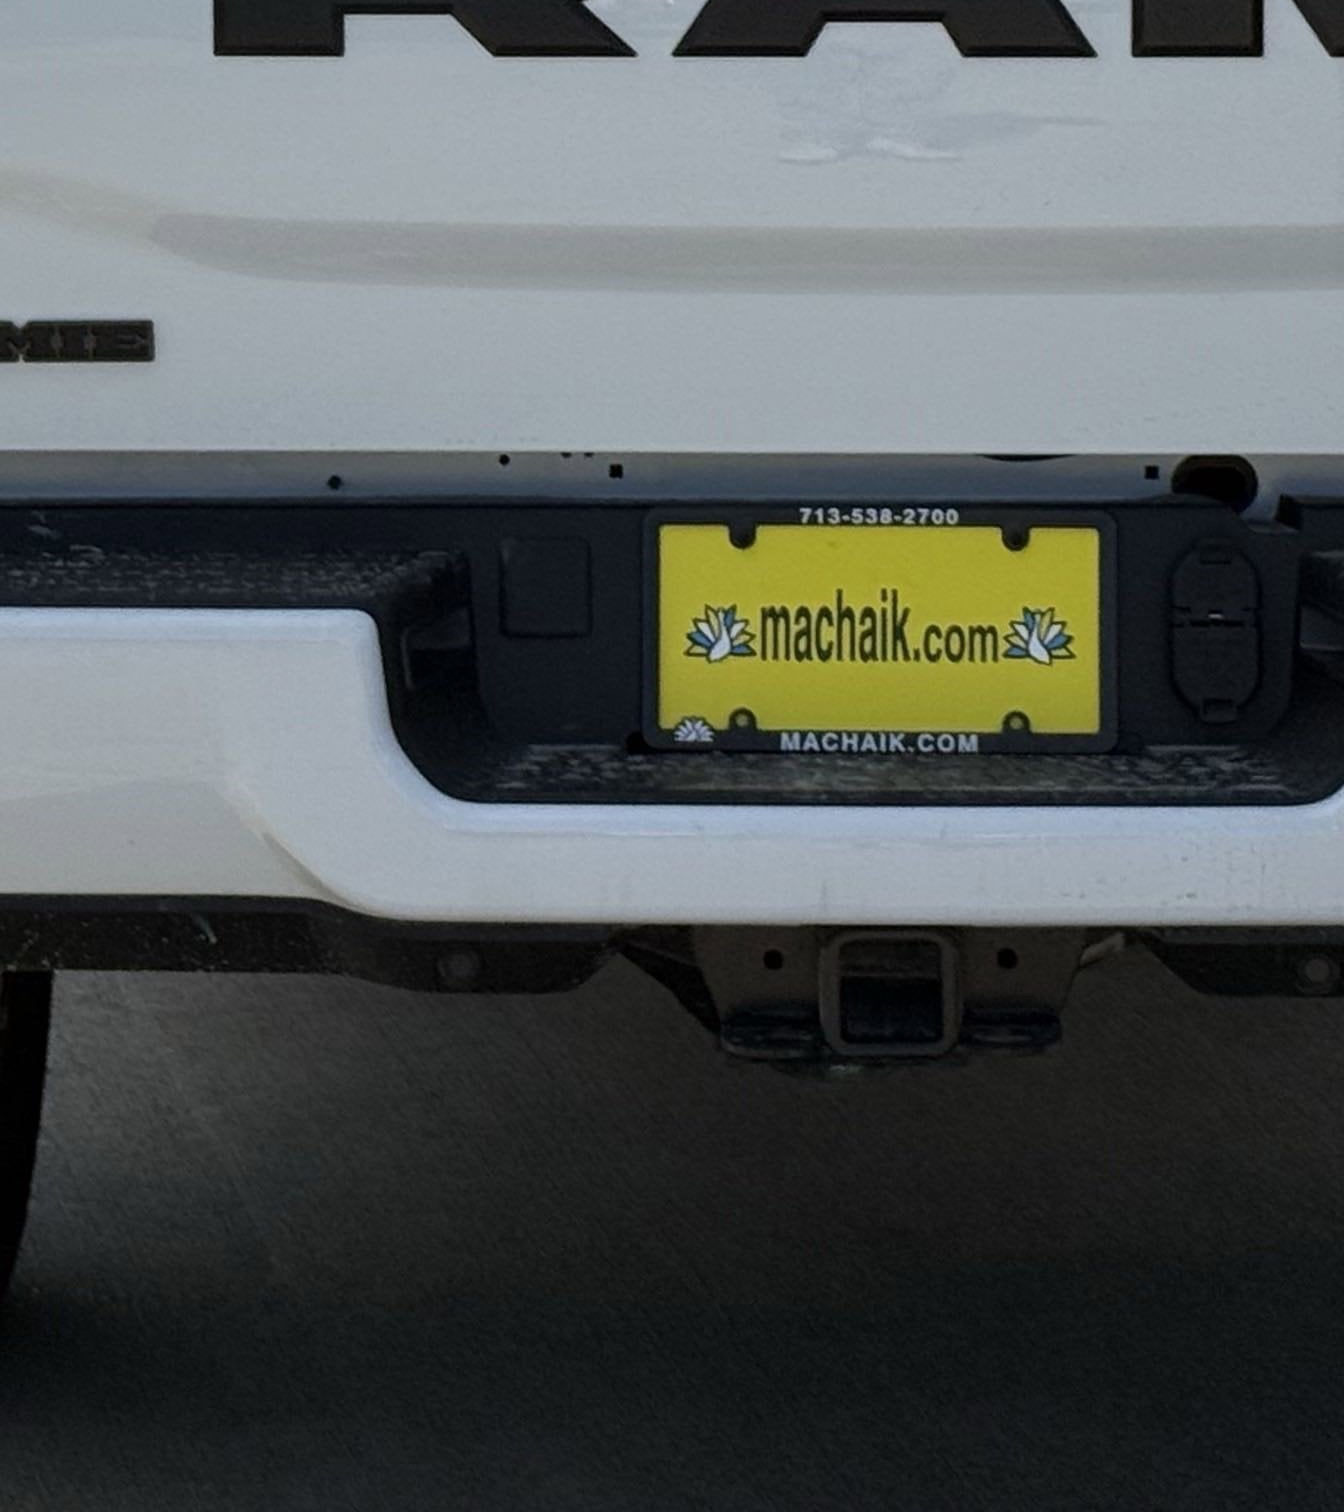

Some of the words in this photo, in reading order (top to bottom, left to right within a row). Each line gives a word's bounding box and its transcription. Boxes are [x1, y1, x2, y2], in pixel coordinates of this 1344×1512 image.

[799, 507, 960, 525] 713-538-2700
[760, 588, 999, 664] machaik.com
[780, 731, 979, 754] MACHAIK.COM
